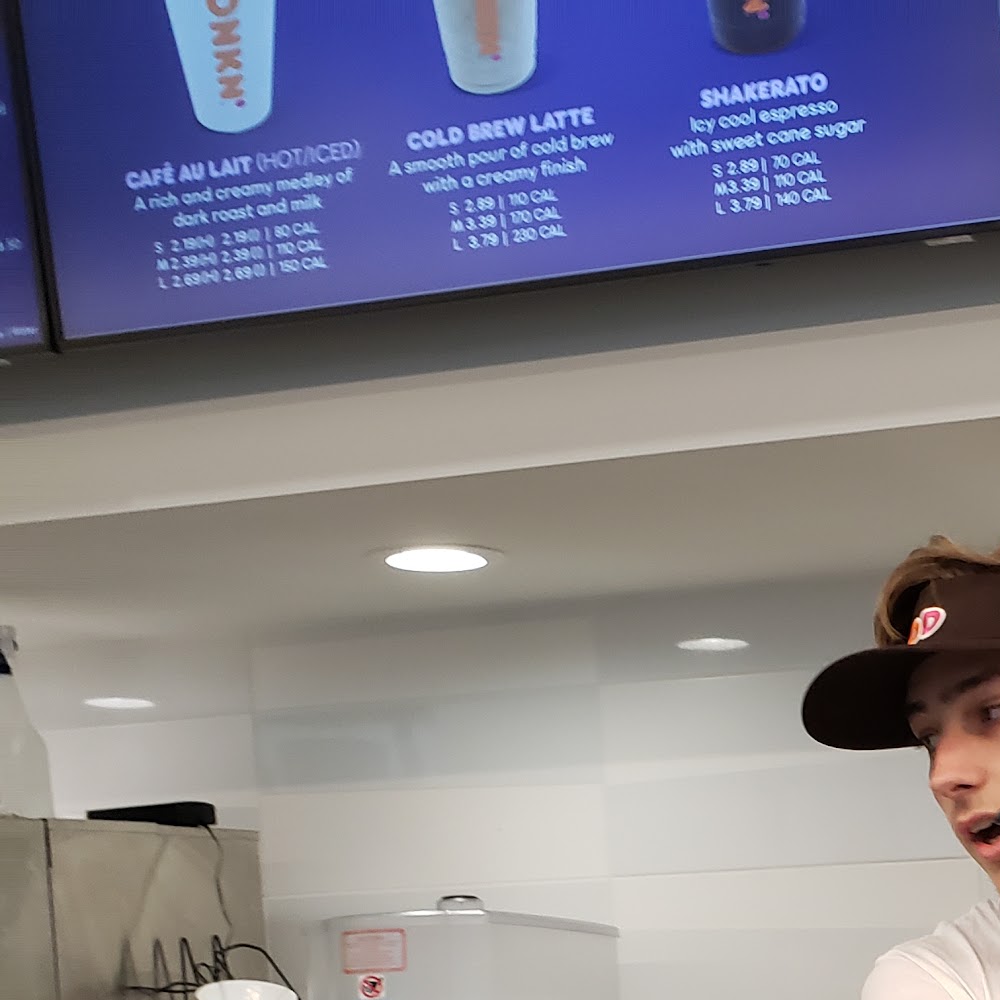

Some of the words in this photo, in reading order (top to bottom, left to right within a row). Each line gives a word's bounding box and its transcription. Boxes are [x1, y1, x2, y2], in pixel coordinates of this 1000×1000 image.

[700, 71, 829, 109] SHAKERATO
[406, 126, 465, 150] COLD
[466, 115, 527, 143] BREW
[529, 106, 596, 133] LATTE
[689, 116, 716, 135] Icy
[718, 107, 757, 130] cool
[758, 99, 840, 124] espresso
[388, 160, 403, 176] A
[403, 152, 466, 174] smooth
[467, 147, 508, 169] pour
[509, 141, 529, 160] of
[531, 133, 569, 156] cold
[570, 132, 615, 151] brew
[670, 138, 709, 159] with
[711, 131, 764, 153] sweet
[766, 126, 812, 145] cane
[813, 118, 867, 139] sugar
[125, 161, 176, 190] CAFÉ
[178, 161, 205, 184] AU
[207, 155, 252, 178] LAIT
[256, 138, 361, 173] (HOT/ICED)
[422, 174, 459, 194] with
[461, 174, 475, 188] a
[476, 165, 539, 186] creamy
[540, 156, 588, 177] finish
[711, 163, 724, 178] S
[771, 154, 791, 170] 70
[791, 150, 822, 167] CAL
[727, 177, 761, 194] 3.39
[773, 172, 796, 188] 110
[796, 168, 828, 185] CAL
[133, 196, 148, 211] A
[148, 191, 180, 208] rich
[181, 185, 214, 207] and
[215, 181, 273, 201] creamy
[276, 171, 332, 192] medley
[335, 166, 354, 185] of
[449, 201, 460, 216] S
[508, 191, 530, 207] 110
[530, 188, 559, 204] CAL
[715, 201, 727, 215] L
[729, 195, 763, 213] 3.79
[775, 190, 801, 207] 140
[801, 186, 833, 203] CAL
[173, 209, 210, 228] dark
[211, 203, 255, 223] roast
[256, 197, 289, 217] and
[290, 193, 324, 212] milk
[450, 219, 466, 233] M
[465, 214, 498, 231] 3.39
[533, 206, 563, 222] CAL
[154, 241, 165, 254] S
[292, 221, 321, 238] CAL
[452, 238, 464, 251] L
[467, 232, 500, 249] 3.79
[512, 227, 539, 243] 230
[538, 223, 568, 239] CAL
[156, 258, 170, 271] M
[297, 238, 326, 254] CAL
[158, 276, 169, 289] L
[301, 255, 329, 271] CAL
